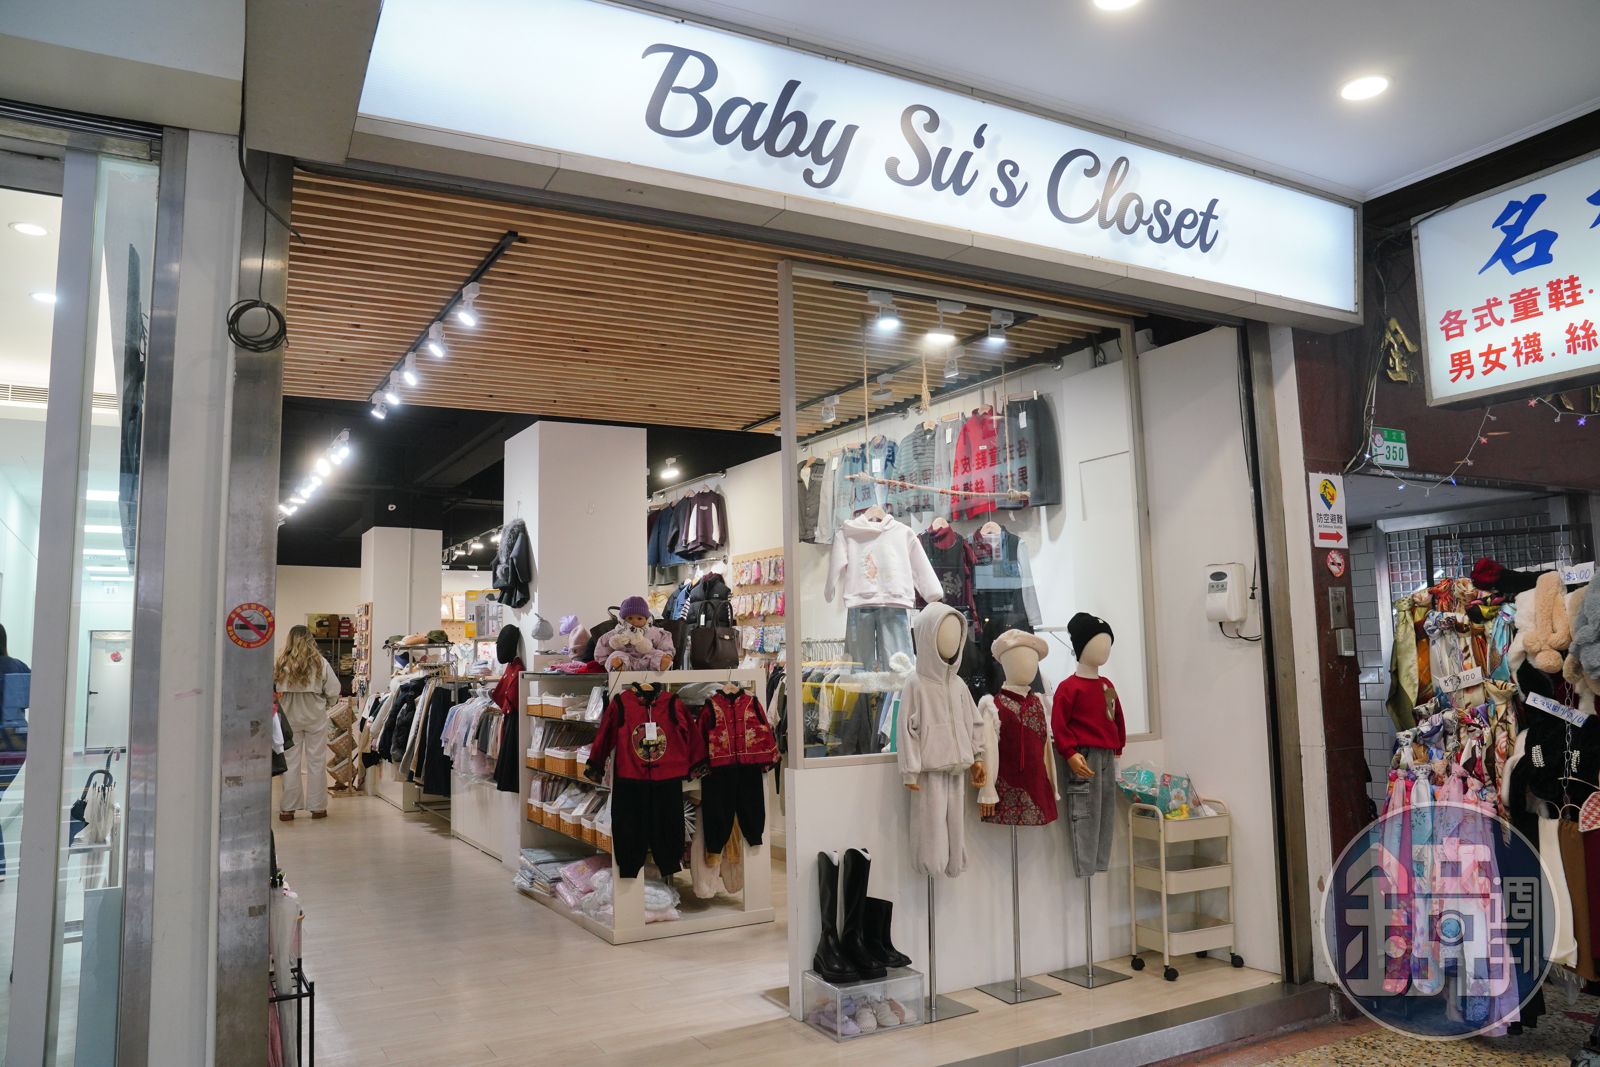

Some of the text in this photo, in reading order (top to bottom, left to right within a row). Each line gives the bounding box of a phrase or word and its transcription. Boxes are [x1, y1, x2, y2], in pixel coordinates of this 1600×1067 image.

[641, 42, 1220, 253] Baby Su's Closet
[1385, 445, 1404, 462] 350
